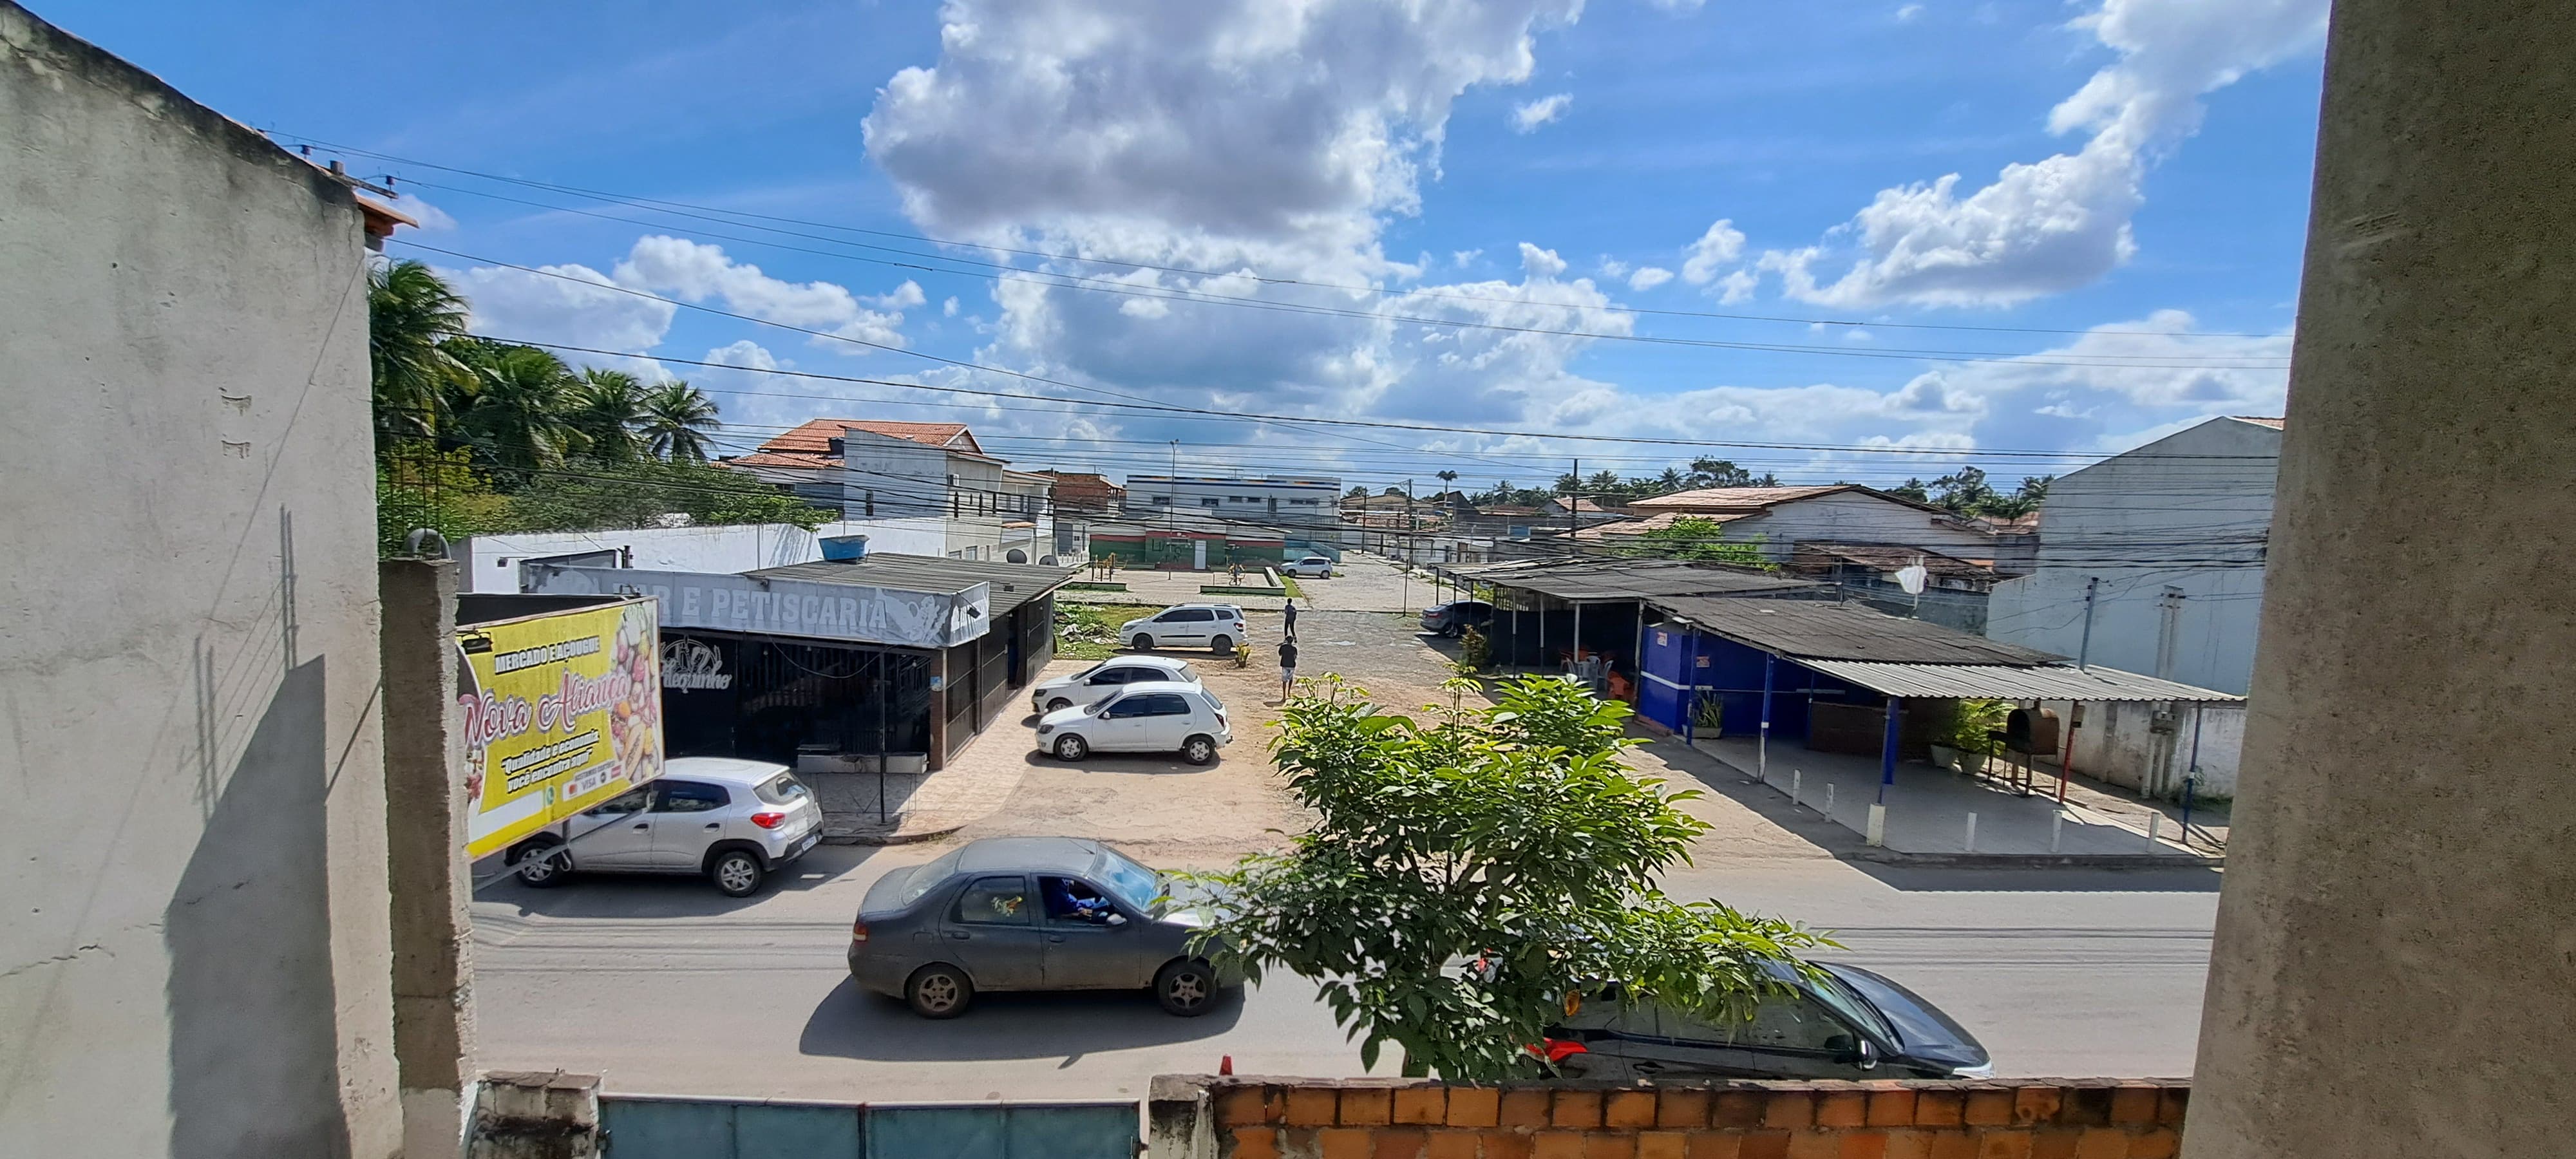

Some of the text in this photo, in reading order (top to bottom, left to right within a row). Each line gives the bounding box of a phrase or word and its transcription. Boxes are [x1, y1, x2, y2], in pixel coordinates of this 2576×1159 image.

[682, 586, 701, 616] E
[711, 587, 887, 629] PETISCARIA
[495, 636, 600, 674] MERCADO E AÇOUGUE
[465, 668, 632, 747] Nova Aliança
[552, 743, 559, 758] e
[507, 769, 531, 794] você
[531, 757, 571, 784] encontra
[581, 777, 596, 791] VISA
